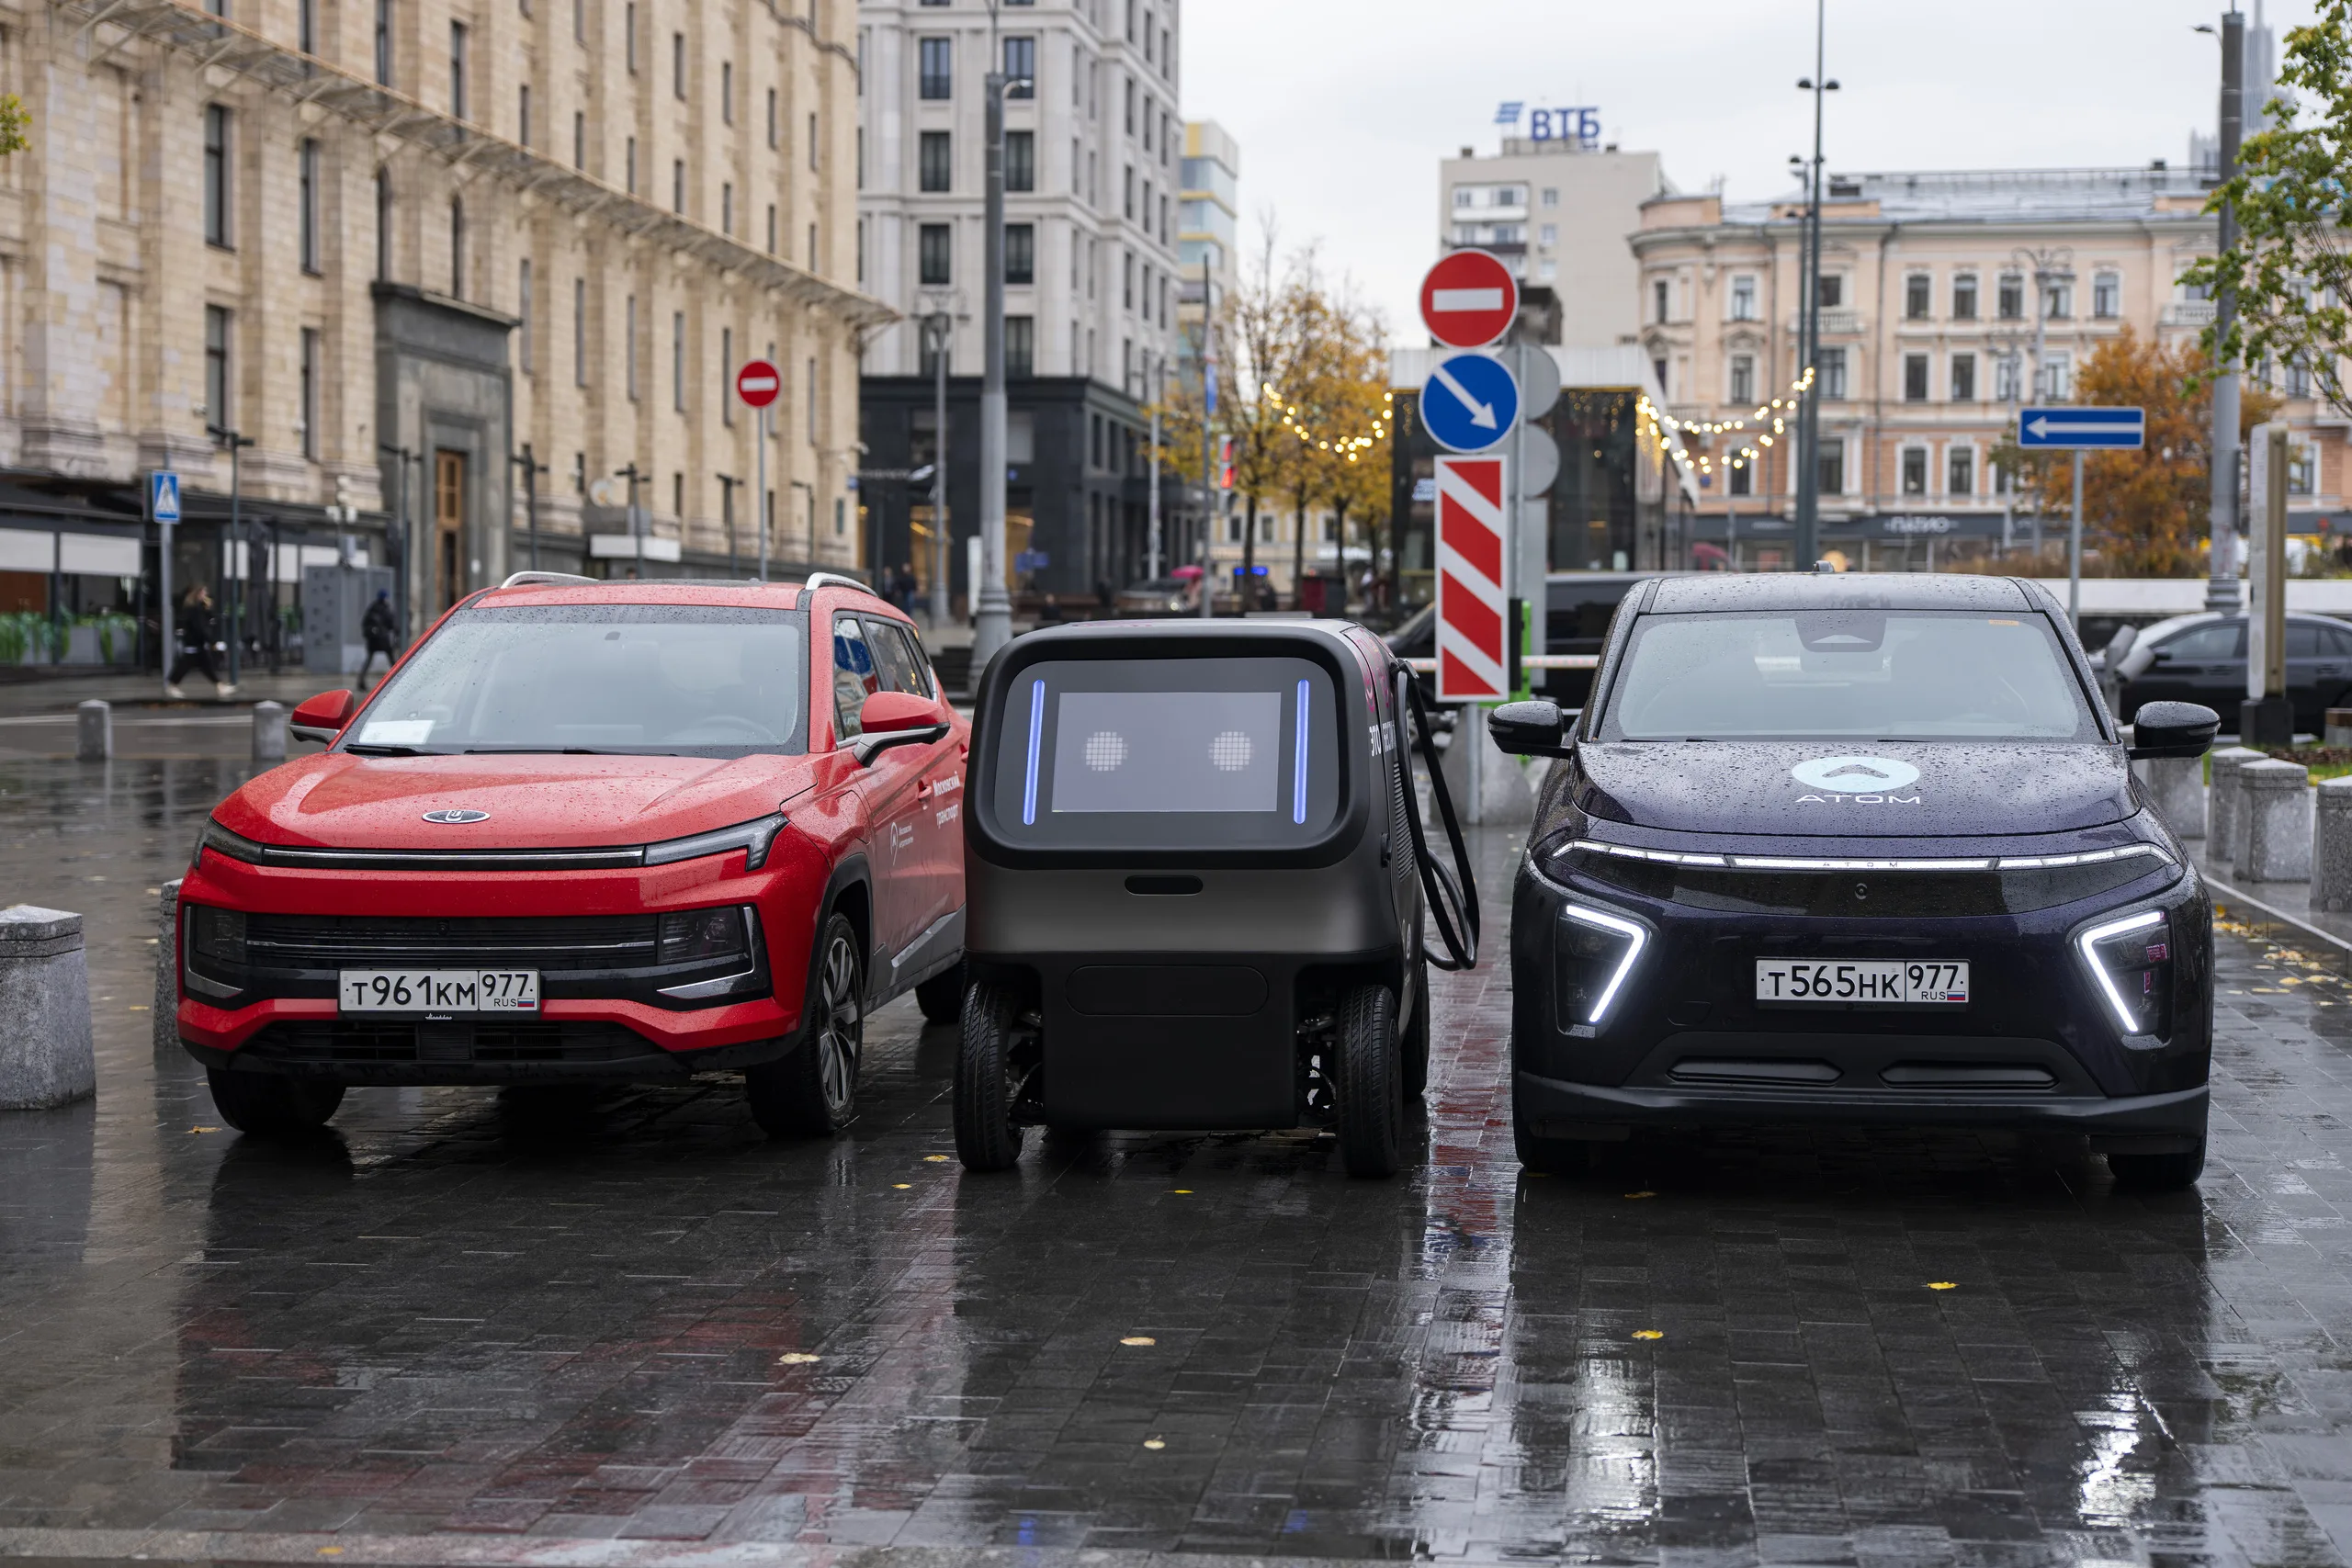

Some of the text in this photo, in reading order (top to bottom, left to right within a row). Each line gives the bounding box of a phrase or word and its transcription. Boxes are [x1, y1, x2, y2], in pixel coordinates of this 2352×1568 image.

[1531, 107, 1600, 141] ВТБ
[1794, 795, 1921, 804] ATOM
[1822, 861, 1898, 869] ATOM
[1907, 964, 1959, 989] 977
[482, 974, 529, 997] 977
[1921, 991, 1946, 1000] RUS
[493, 998, 516, 1007] RUS
